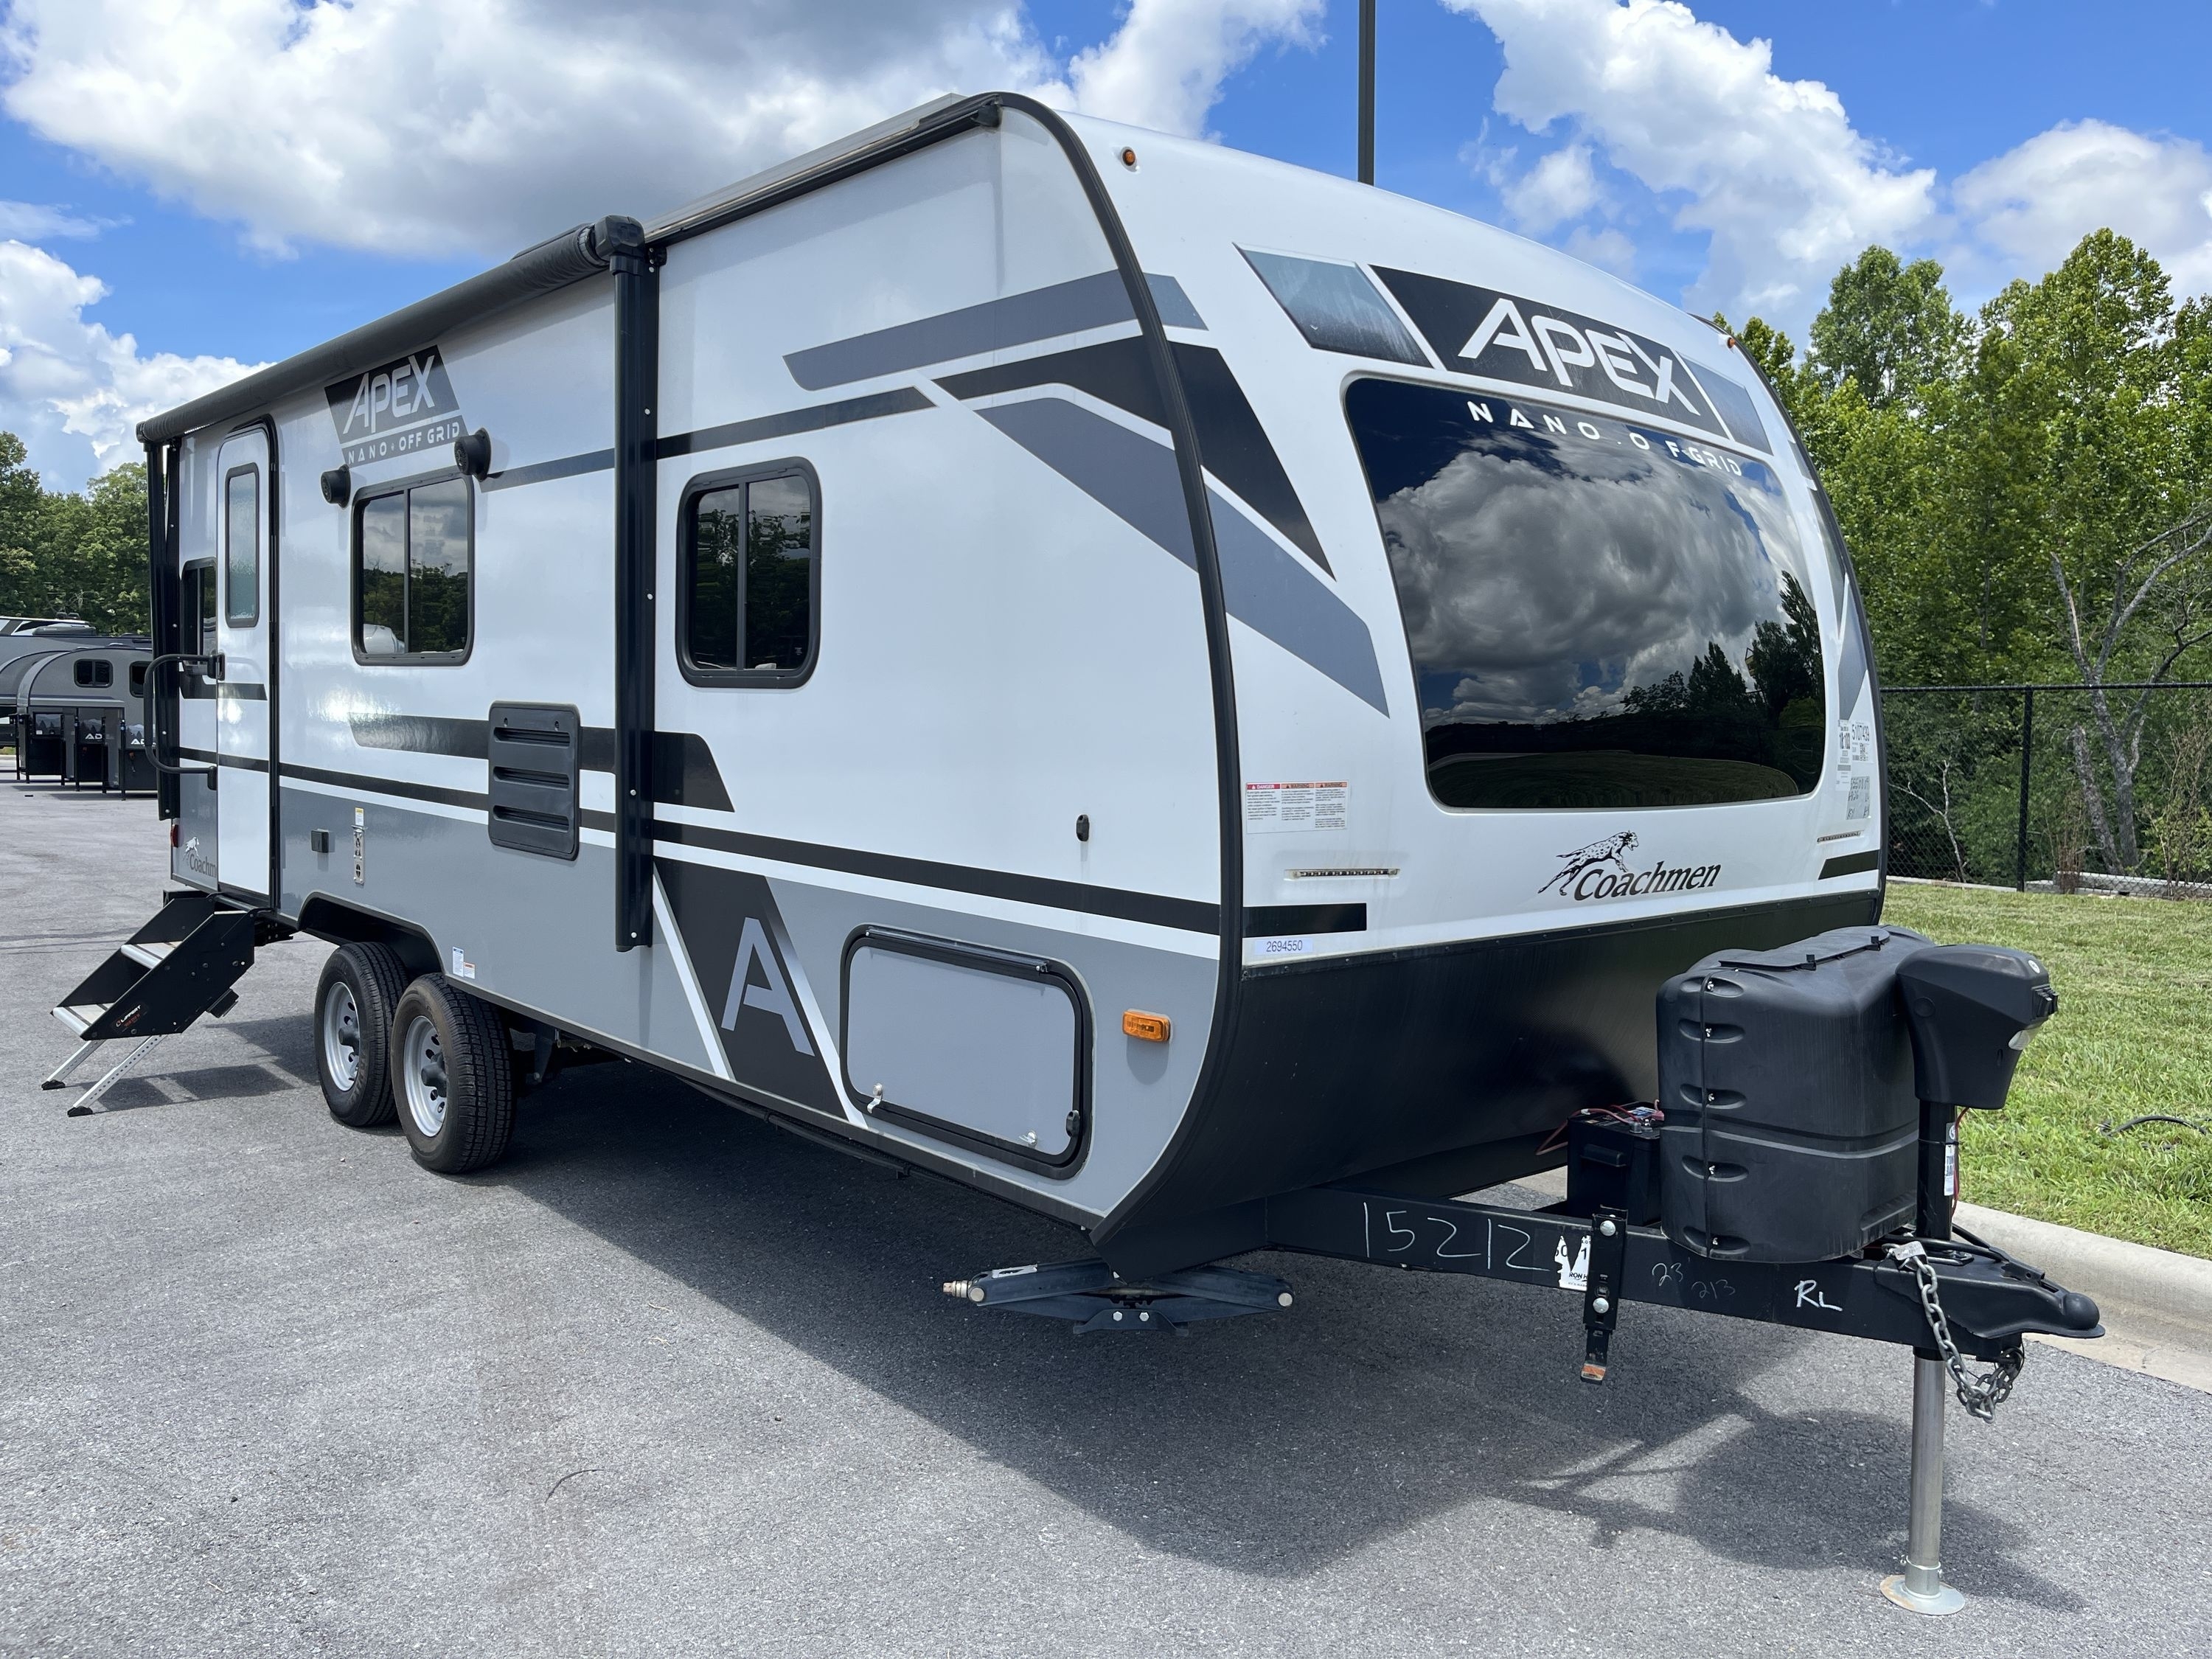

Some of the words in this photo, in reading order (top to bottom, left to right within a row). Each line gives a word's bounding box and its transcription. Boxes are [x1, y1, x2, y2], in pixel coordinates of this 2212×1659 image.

[1458, 298, 1700, 415] APEX
[343, 355, 434, 434] APEX
[347, 442, 387, 465] NANO
[399, 431, 422, 451] OFF
[427, 421, 460, 444] GRID
[1573, 860, 1722, 901] Coachmen
[1266, 940, 1303, 952] 2694550
[721, 917, 815, 1057] A
[1363, 1201, 1551, 1272] 15212
